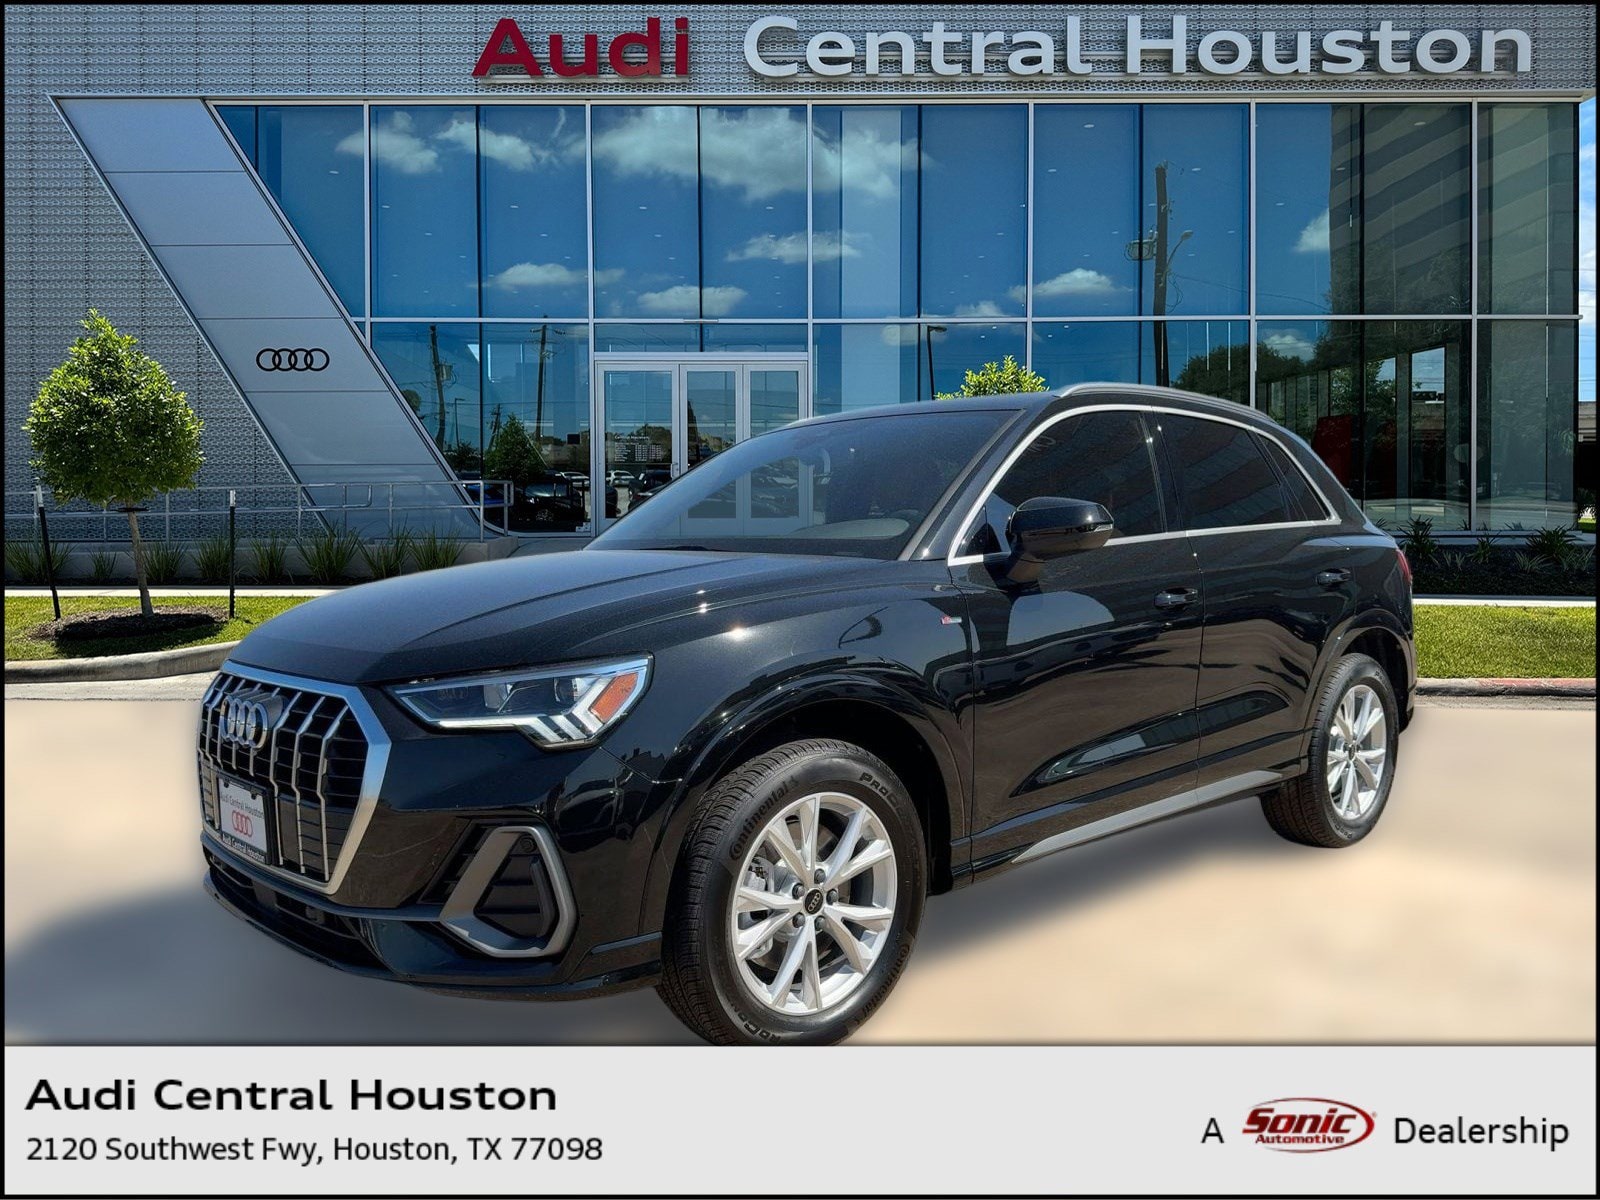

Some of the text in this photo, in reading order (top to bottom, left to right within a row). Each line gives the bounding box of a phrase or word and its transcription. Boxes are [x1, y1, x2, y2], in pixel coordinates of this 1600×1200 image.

[472, 15, 1532, 77] Audi Central Houston
[229, 794, 245, 811] Central
[245, 802, 265, 820] Houston
[232, 837, 247, 853] Central
[247, 843, 266, 864] Houston
